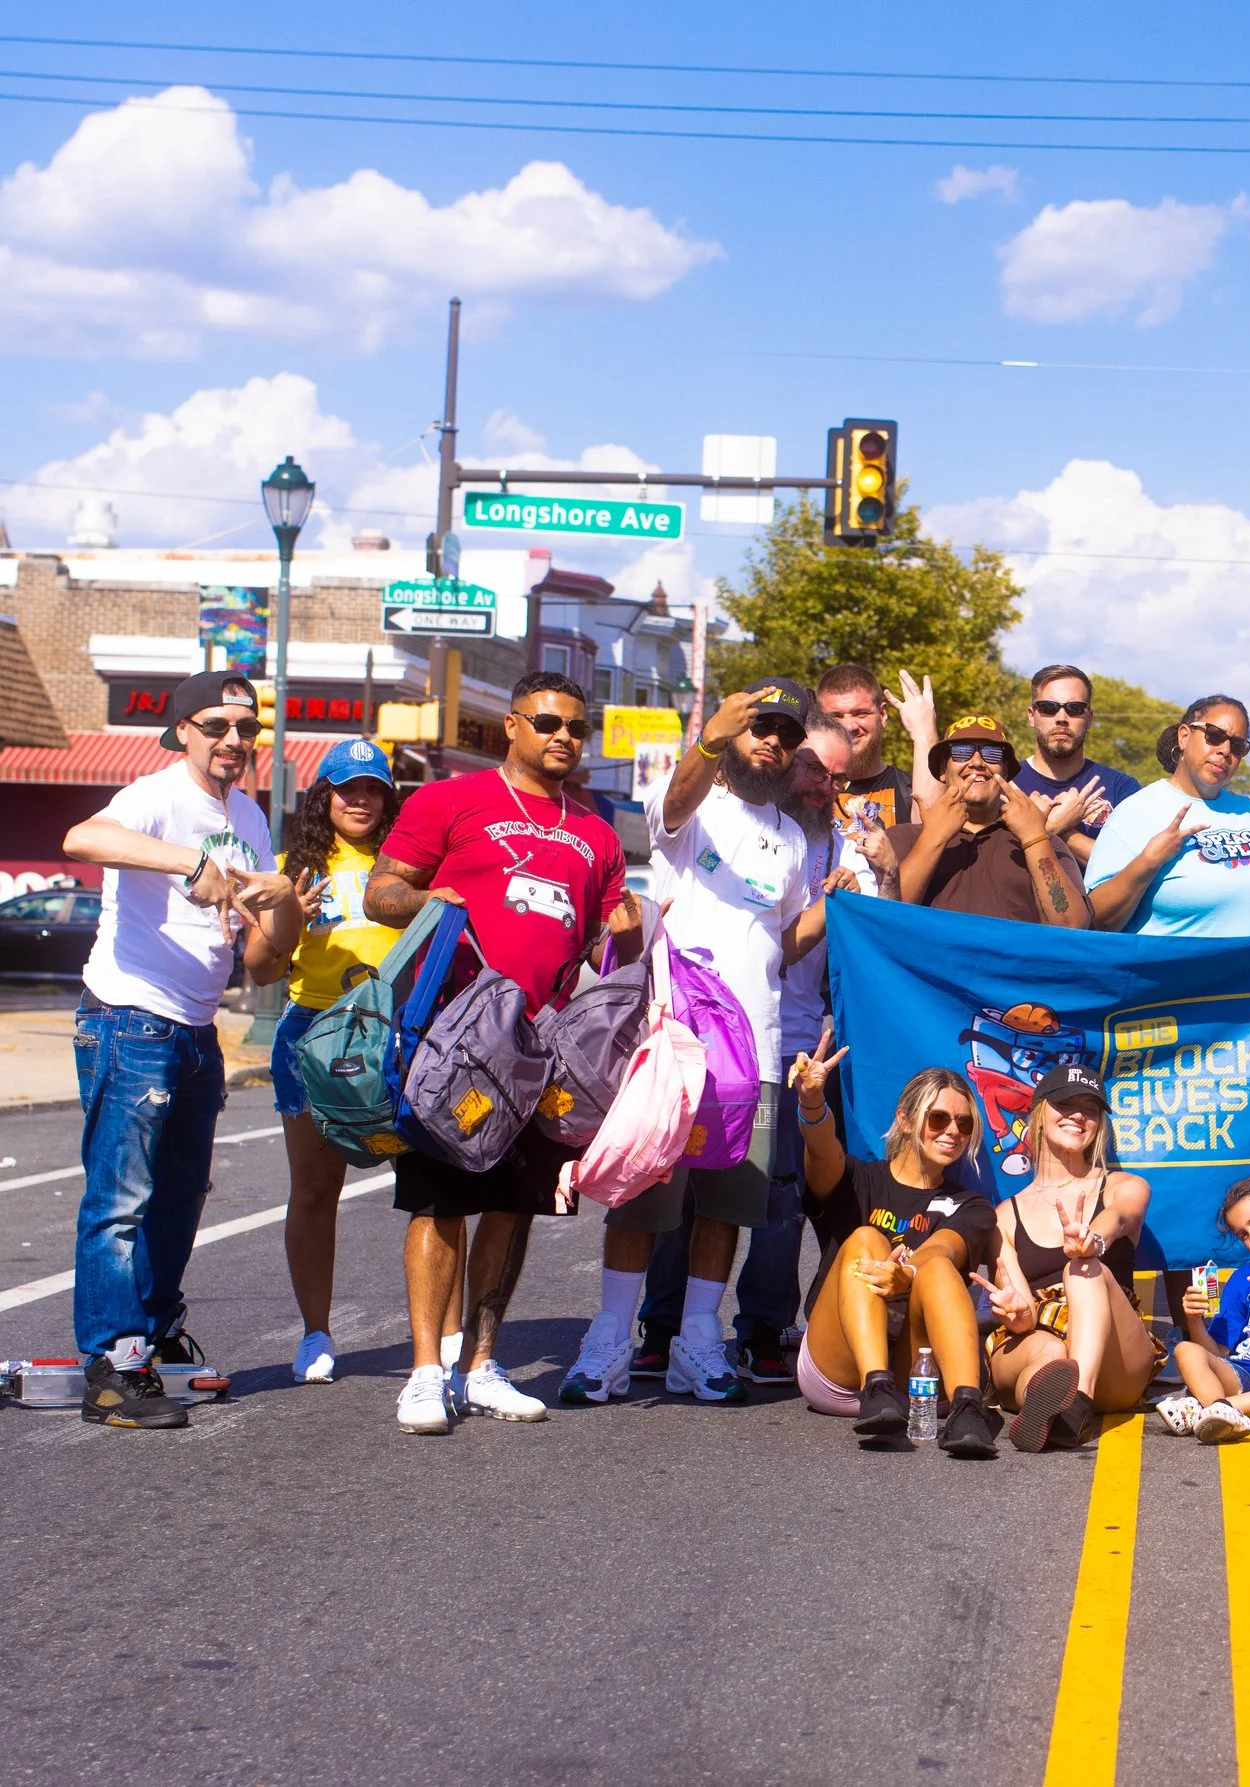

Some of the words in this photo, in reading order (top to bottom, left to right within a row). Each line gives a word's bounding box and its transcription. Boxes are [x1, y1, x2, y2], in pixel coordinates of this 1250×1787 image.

[475, 499, 611, 530] Longshore
[620, 507, 671, 532] Ave
[385, 585, 468, 608] Longshore
[413, 615, 443, 625] ONE
[448, 617, 479, 626] WAY
[124, 690, 169, 714] J&J
[484, 821, 595, 868] EXCALIBUR
[1119, 1020, 1173, 1046] THE
[1067, 1073, 1100, 1090] Block
[1110, 1077, 1249, 1116] GIVES
[1112, 1114, 1235, 1152] BACK
